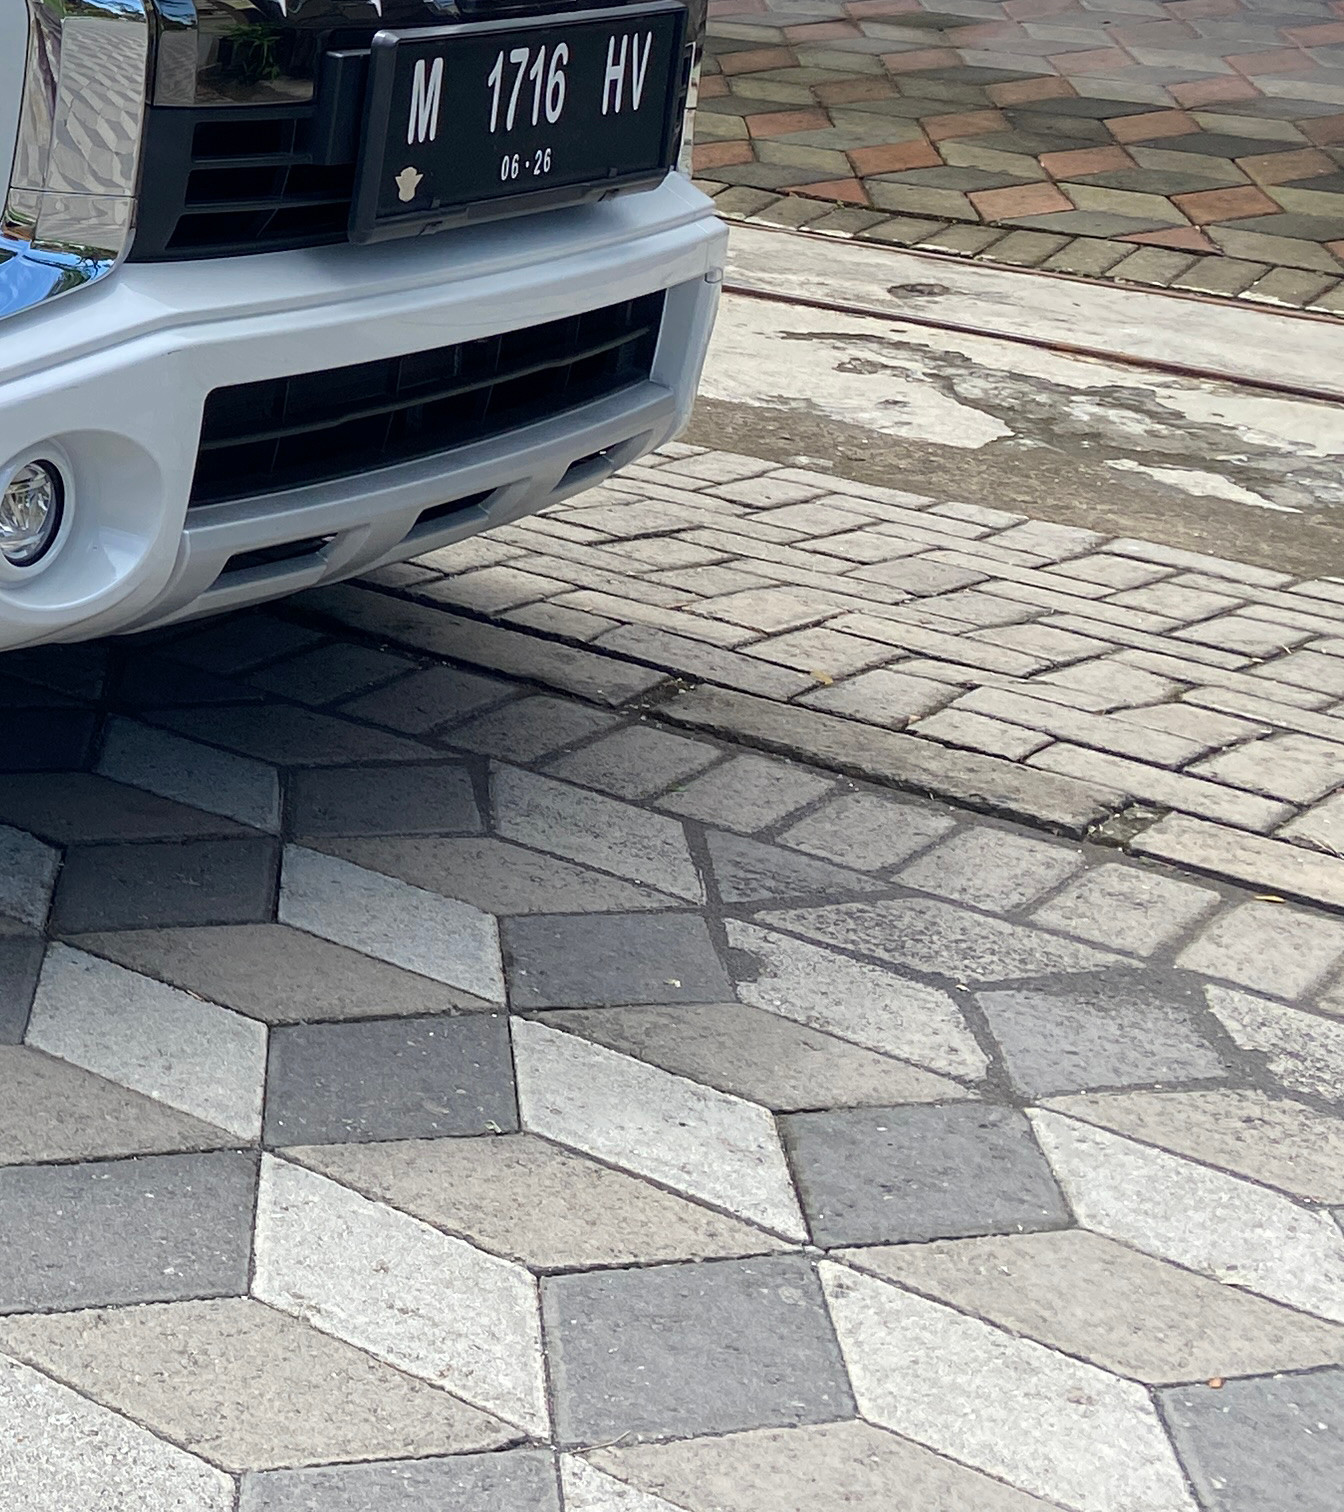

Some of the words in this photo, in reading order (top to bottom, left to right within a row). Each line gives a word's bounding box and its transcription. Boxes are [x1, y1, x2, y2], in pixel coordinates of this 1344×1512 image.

[407, 57, 444, 145] M
[487, 42, 569, 133] 1716
[602, 31, 652, 115] HV
